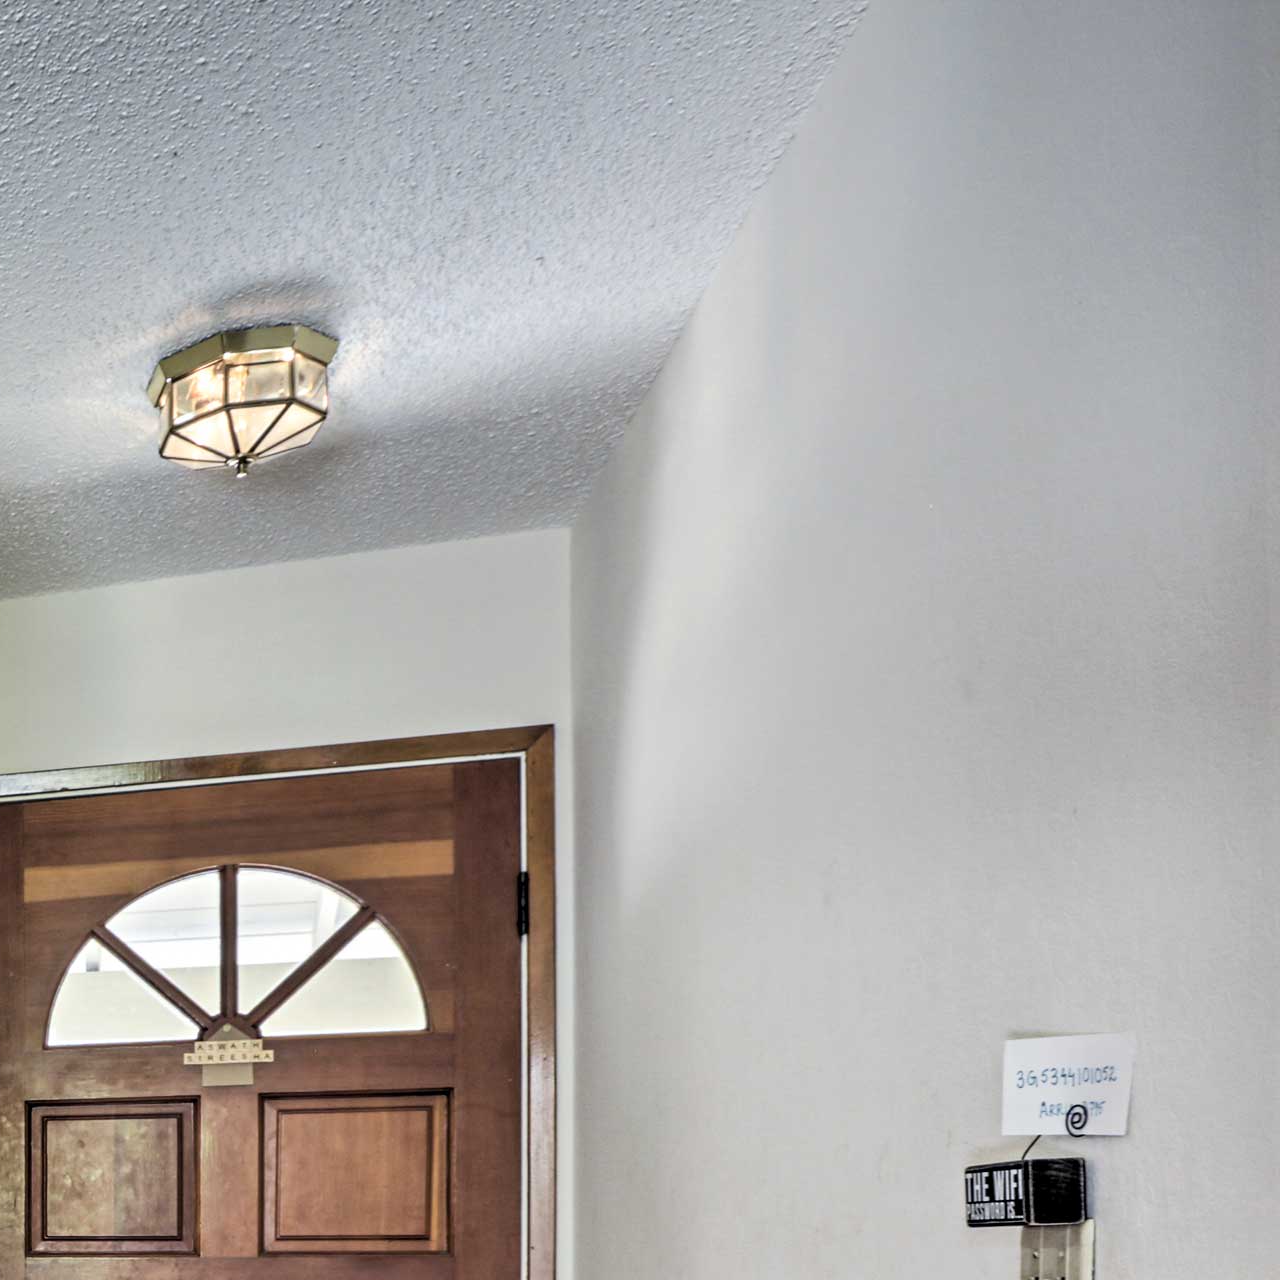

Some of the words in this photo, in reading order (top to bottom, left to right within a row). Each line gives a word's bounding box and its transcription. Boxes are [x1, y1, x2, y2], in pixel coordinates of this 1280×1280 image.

[966, 1172, 990, 1202] THE
[993, 1169, 1024, 1200] WIFI
[966, 1202, 1005, 1220] PASSWORD
